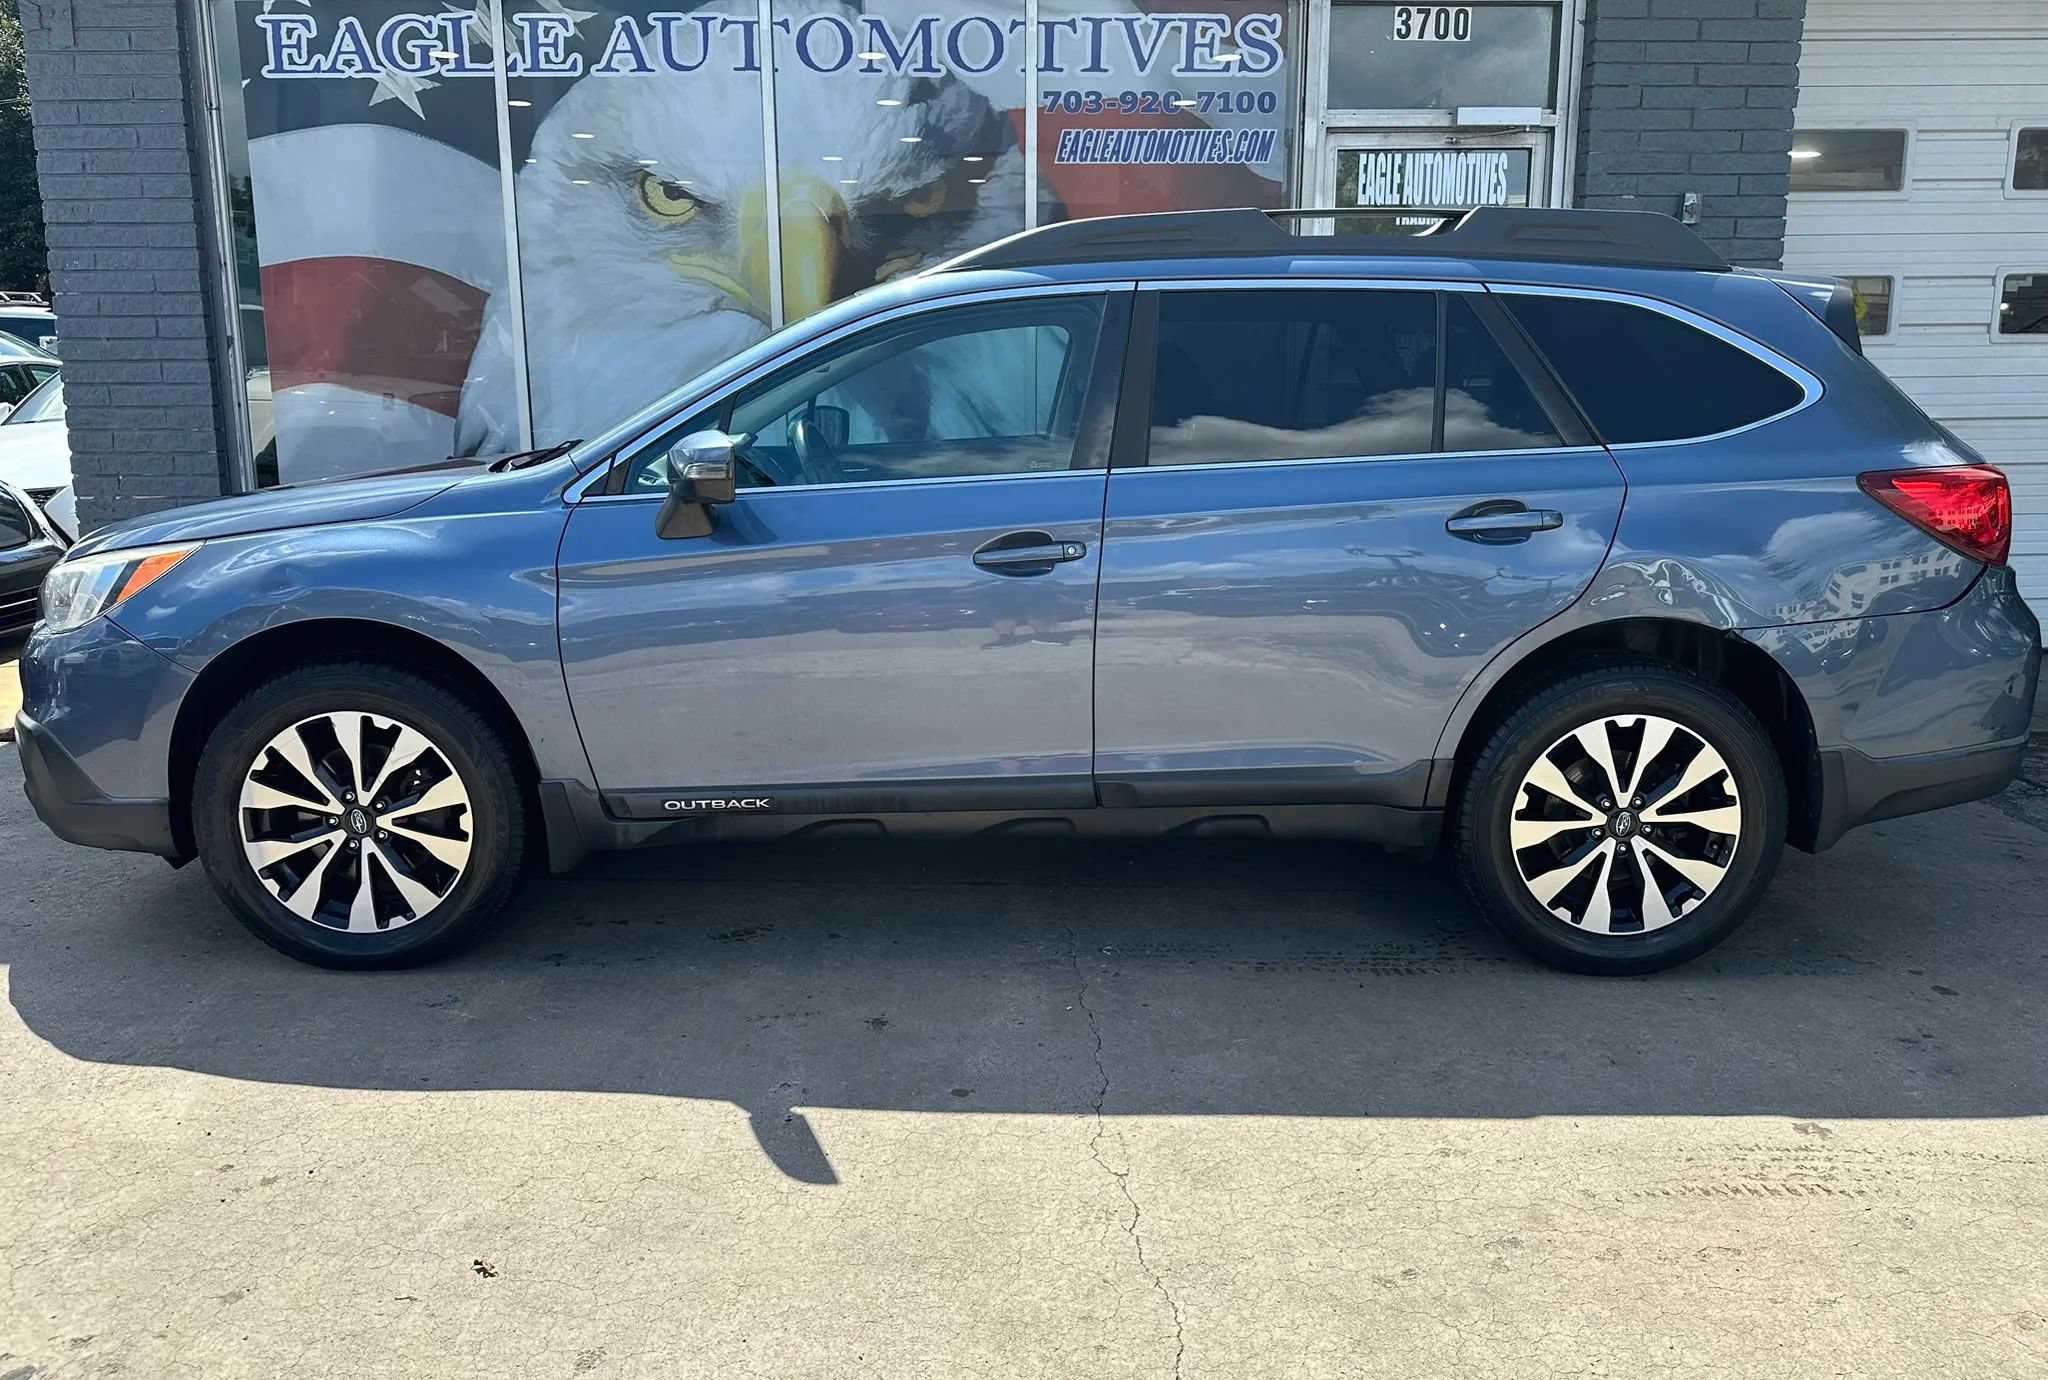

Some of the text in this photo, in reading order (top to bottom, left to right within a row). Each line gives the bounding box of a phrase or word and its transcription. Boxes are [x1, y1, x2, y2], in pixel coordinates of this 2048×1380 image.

[1395, 6, 1470, 41] 3700
[256, 12, 1284, 78] EAGLE AUTOMOTIVES
[1043, 90, 1277, 115] 703-920-7100
[1055, 129, 1276, 164] EAGLEAUTOMOTIVES.COM
[1357, 152, 1508, 206] EAGLE AUTOMOTIVES
[664, 798, 770, 811] OUTBACK
